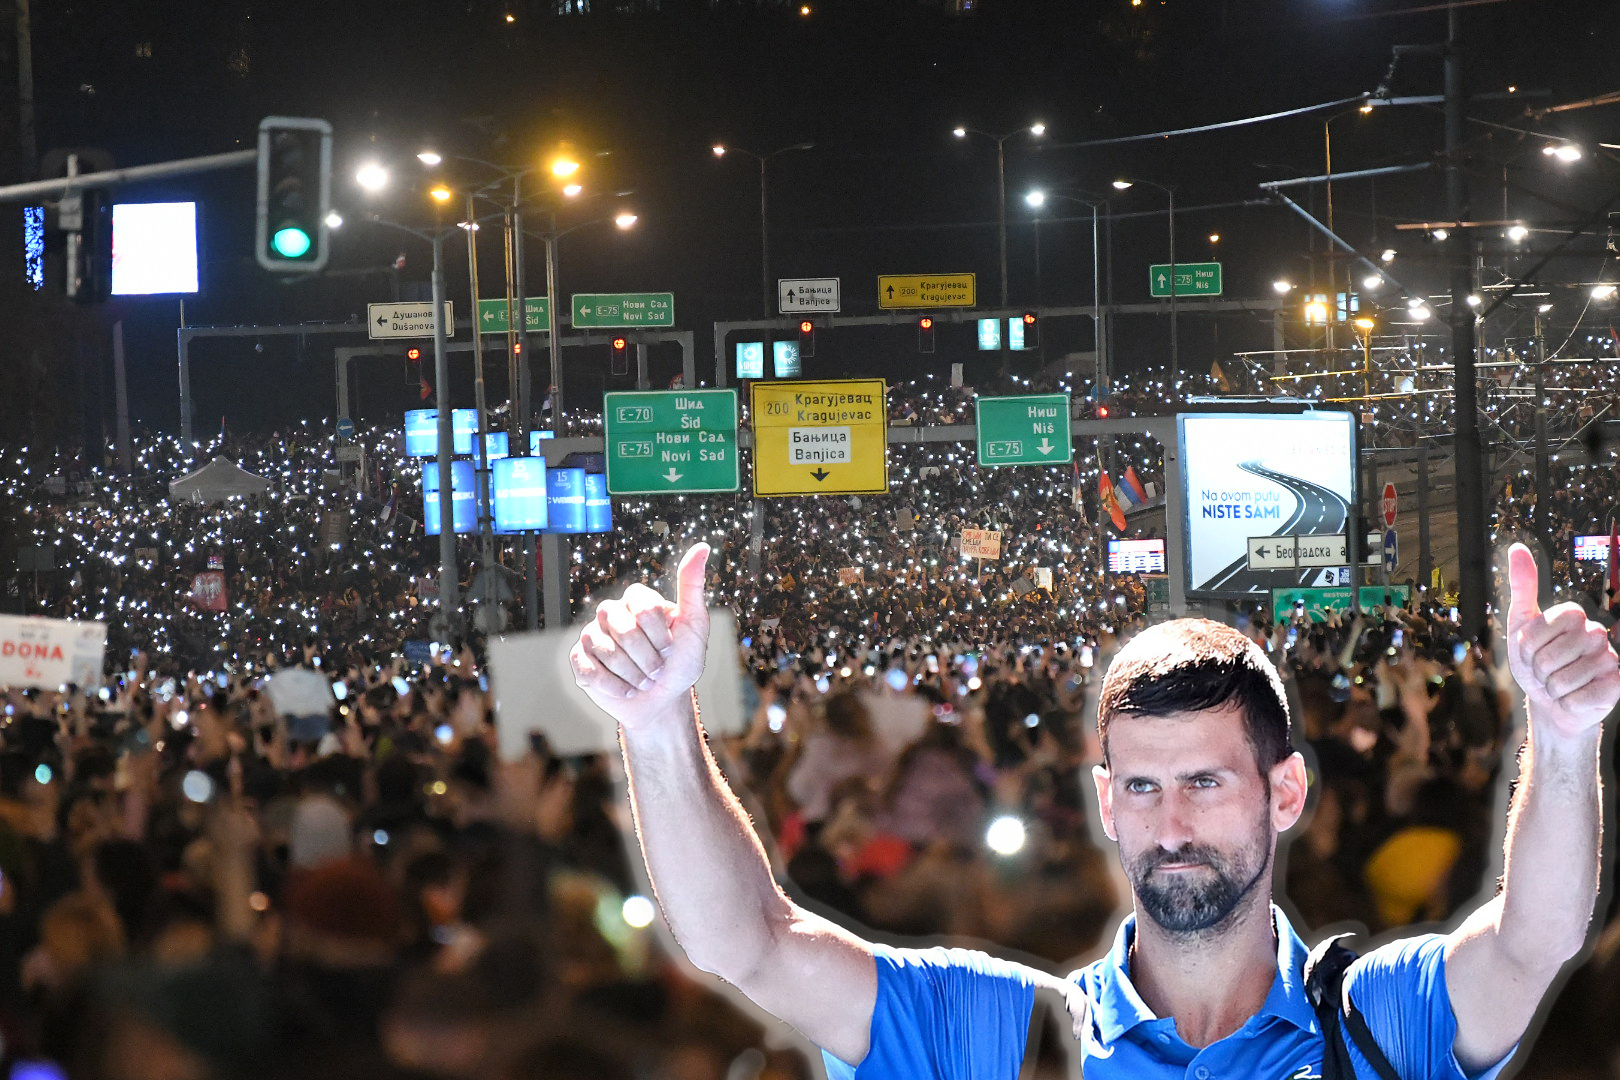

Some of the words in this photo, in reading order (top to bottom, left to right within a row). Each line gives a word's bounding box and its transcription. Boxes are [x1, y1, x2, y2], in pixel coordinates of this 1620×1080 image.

[920, 282, 968, 290] Крагујевац
[800, 298, 830, 306] Banjica
[920, 293, 966, 302] Kragujevac
[623, 301, 645, 309] Нови
[650, 300, 668, 308] Сад
[393, 312, 434, 320] Душанов
[597, 307, 618, 315] E-75
[648, 312, 665, 320] Sad
[526, 315, 539, 325] Šid
[392, 323, 435, 331] Dušanova
[675, 398, 704, 410] Шид
[795, 394, 872, 406] Крагујевац
[767, 402, 789, 415] 200
[1028, 406, 1057, 418] Ниш
[620, 409, 650, 421] E-70
[797, 410, 872, 423] Kragujevac
[681, 414, 700, 429] Šid
[1033, 423, 1054, 434] Niš
[656, 432, 690, 444] Нови
[699, 431, 726, 443] Сад
[793, 432, 847, 443] Бањица
[621, 443, 651, 456] E-75
[661, 450, 691, 462] Novi
[699, 449, 725, 461] Sad
[795, 449, 845, 462] Banjica
[989, 443, 1020, 456] E-75
[557, 472, 568, 482] 15
[1202, 489, 1217, 500] Na
[1221, 492, 1251, 501] ovom
[1254, 490, 1280, 504] putu
[1202, 504, 1241, 519] NISTE
[1244, 504, 1280, 519] SAMI
[1276, 545, 1331, 558] Беорадска
[2, 641, 64, 661] DONA
